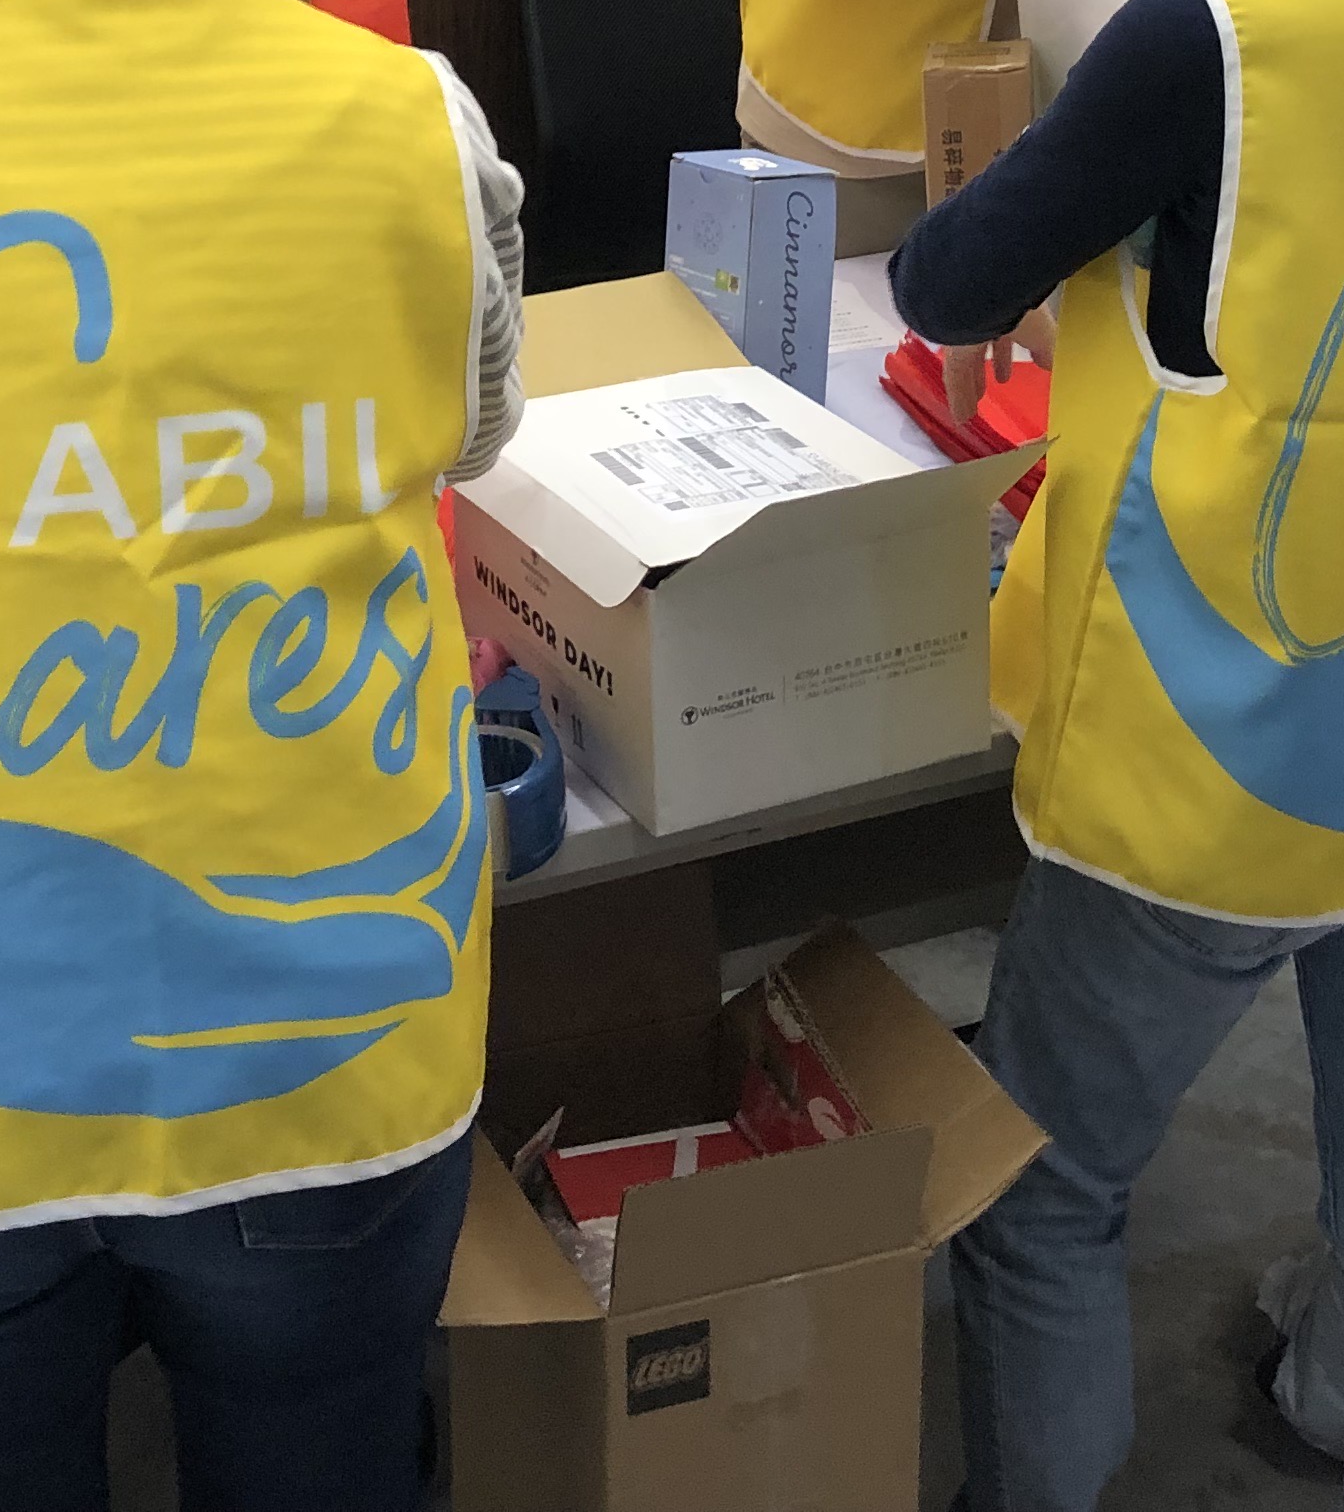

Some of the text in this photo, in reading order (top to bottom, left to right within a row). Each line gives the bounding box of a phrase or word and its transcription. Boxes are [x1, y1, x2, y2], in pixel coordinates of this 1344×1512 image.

[780, 190, 814, 386] Cinnamor
[474, 555, 557, 650] WINDSOR
[564, 636, 614, 697] DAY!
[745, 691, 775, 706] HOTEL
[633, 1346, 706, 1388] LEGO
